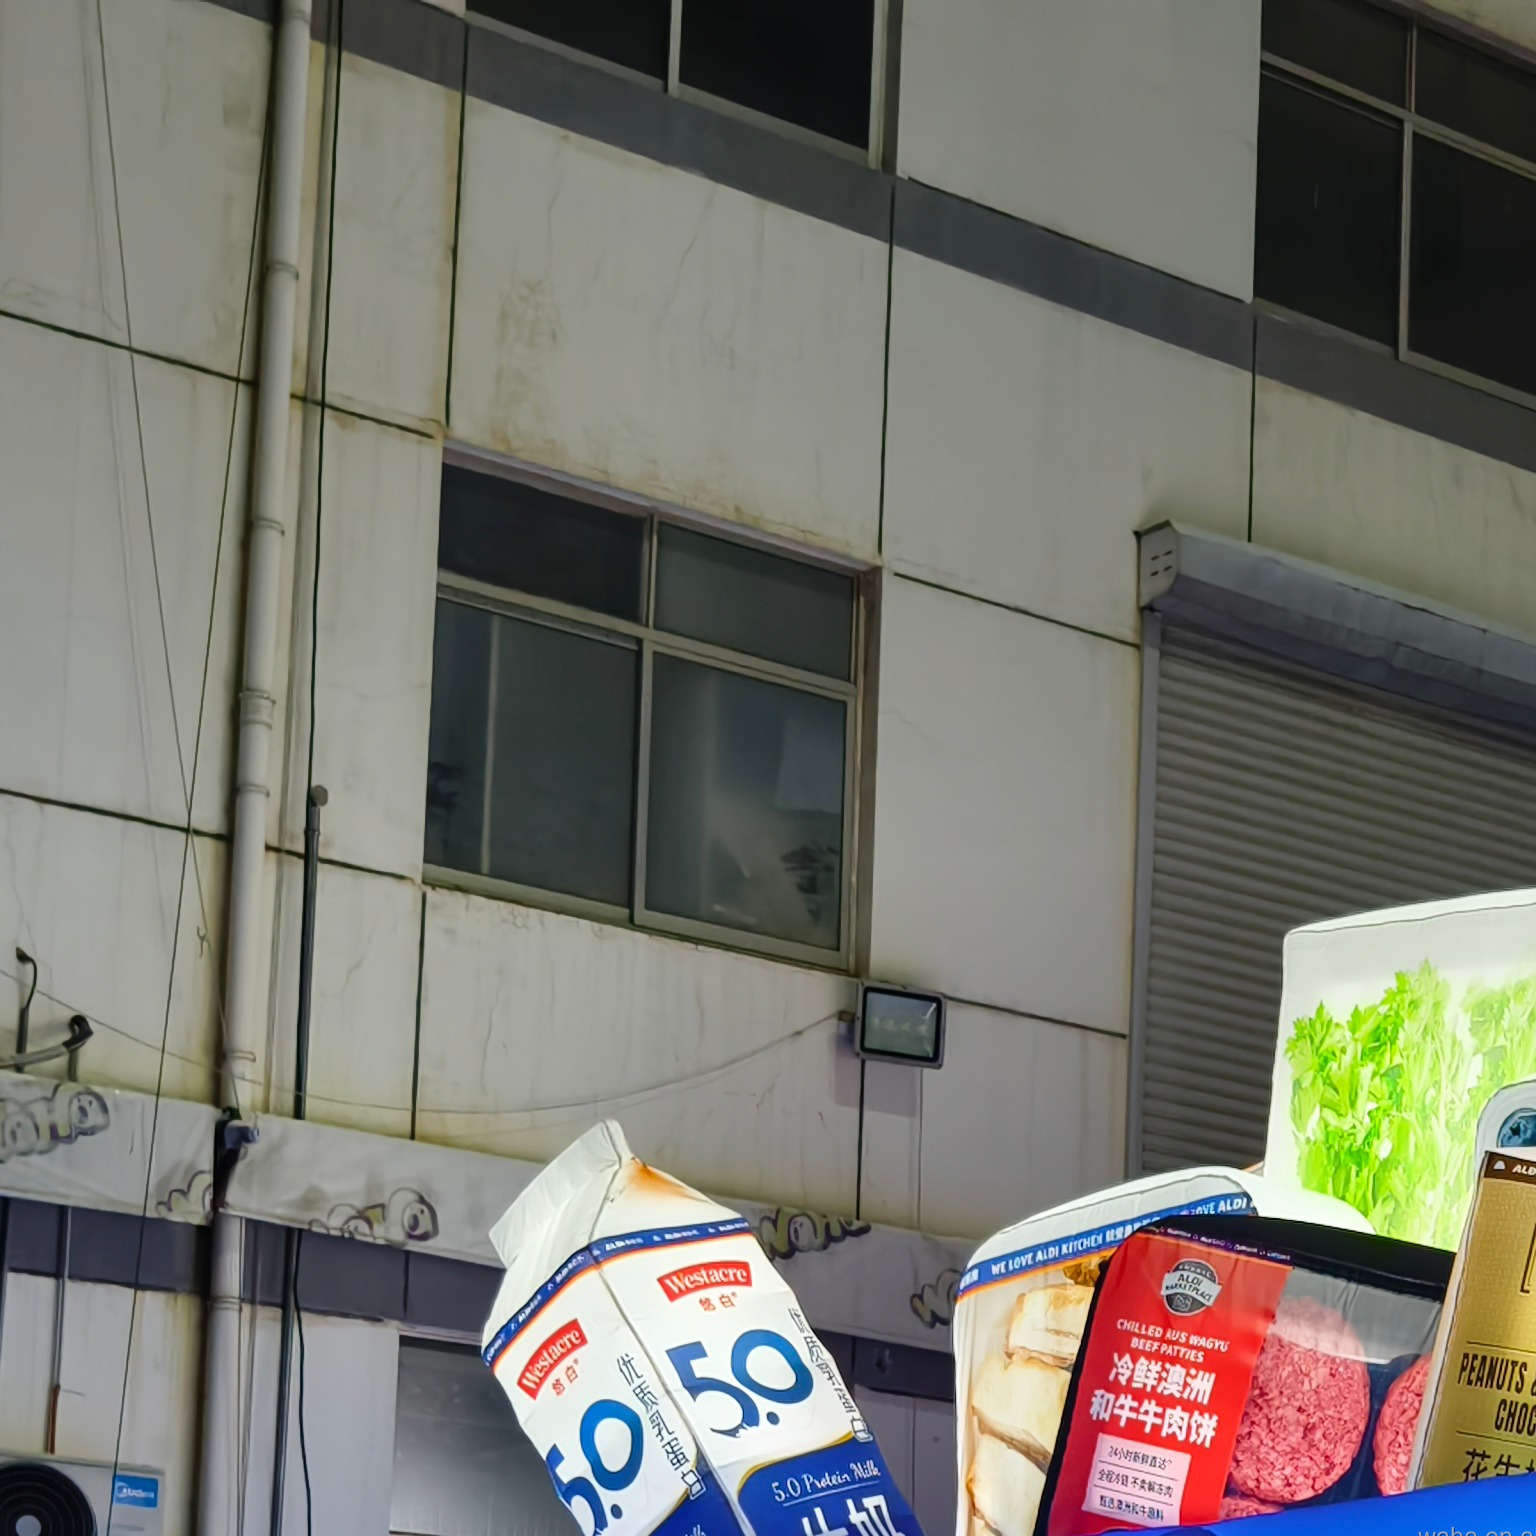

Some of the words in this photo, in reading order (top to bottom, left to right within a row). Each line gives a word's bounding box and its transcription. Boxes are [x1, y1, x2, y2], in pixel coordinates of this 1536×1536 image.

[1217, 1197, 1248, 1213] ALDI
[665, 1265, 747, 1294] Westacre
[1008, 1252, 1034, 1271] LOVE
[1036, 1246, 1059, 1262] ALDI
[1117, 1319, 1163, 1337] CHILLED
[1166, 1328, 1188, 1343] AUS
[1189, 1332, 1230, 1352] WAGYU
[1130, 1337, 1160, 1353] BEEF
[1160, 1344, 1205, 1363] PATTIES
[521, 1330, 581, 1389] Westacre
[1109, 1353, 1216, 1405] 冷鲜澳洲
[1457, 1352, 1528, 1395] PEANUTS
[665, 1329, 813, 1438] 5.0
[1090, 1389, 1218, 1448] 和牛牛肉饼
[772, 1477, 800, 1502] 5.0
[801, 1471, 850, 1493] Protein
[850, 1460, 881, 1481] Milk
